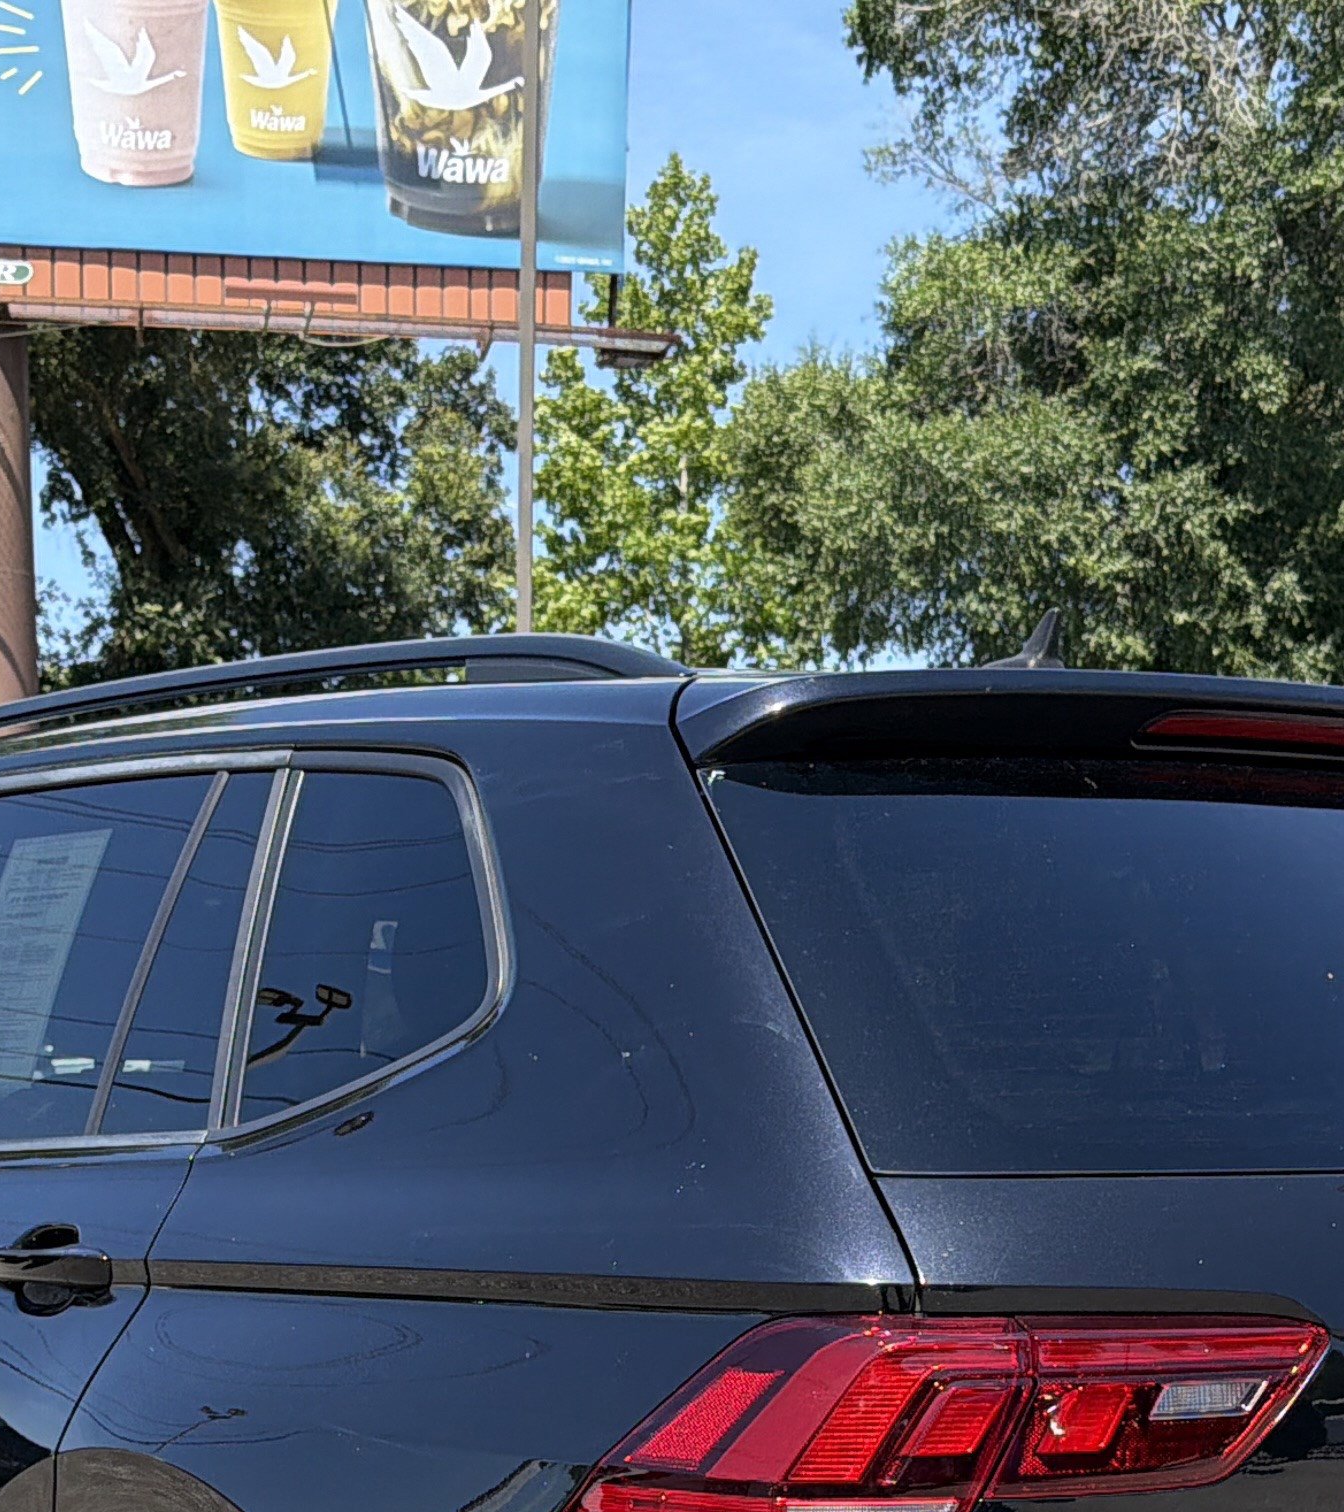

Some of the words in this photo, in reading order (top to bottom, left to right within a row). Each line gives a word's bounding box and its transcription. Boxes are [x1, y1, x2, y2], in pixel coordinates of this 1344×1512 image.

[100, 119, 172, 150] Wawa
[250, 107, 305, 131] Wawa
[416, 140, 510, 185] Wawa
